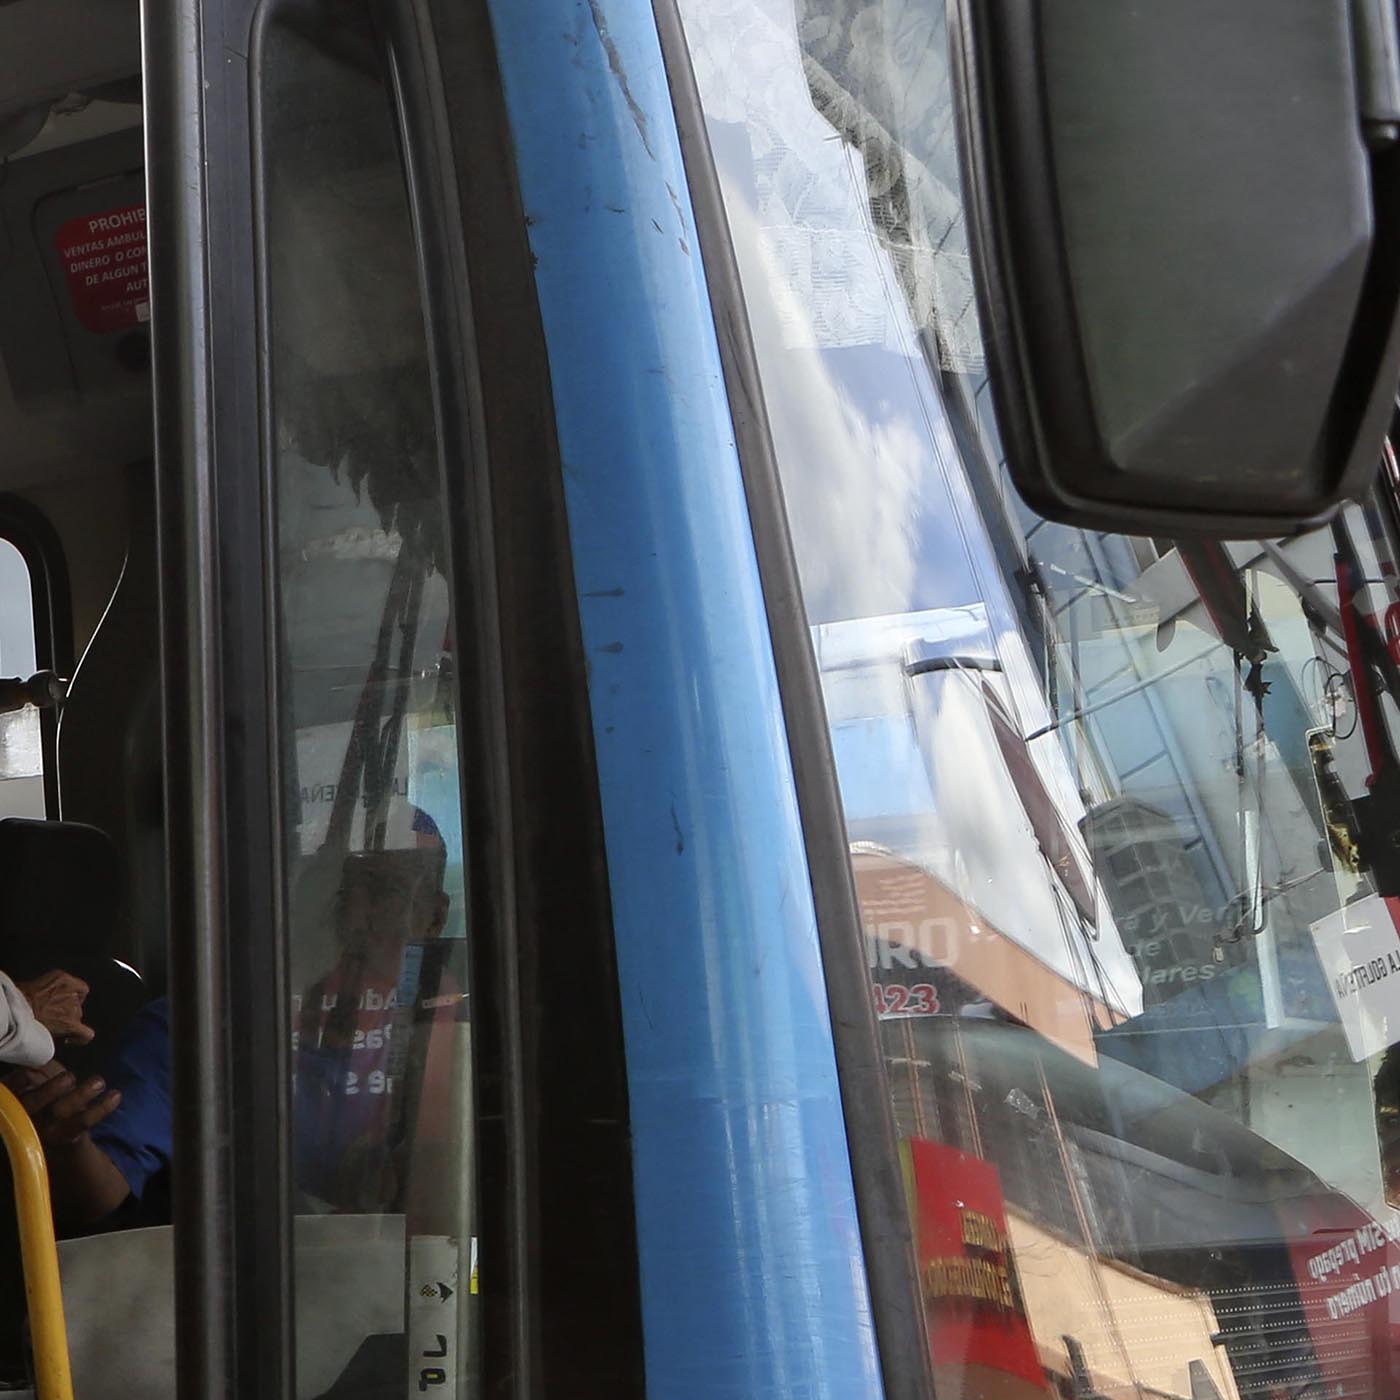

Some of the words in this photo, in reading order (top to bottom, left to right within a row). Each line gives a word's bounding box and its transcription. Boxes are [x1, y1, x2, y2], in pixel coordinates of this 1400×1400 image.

[63, 239, 105, 258] VENTAS
[70, 255, 110, 273] DINERO
[115, 252, 125, 262] O
[86, 274, 99, 286] DE
[102, 265, 139, 282] ALGUN
